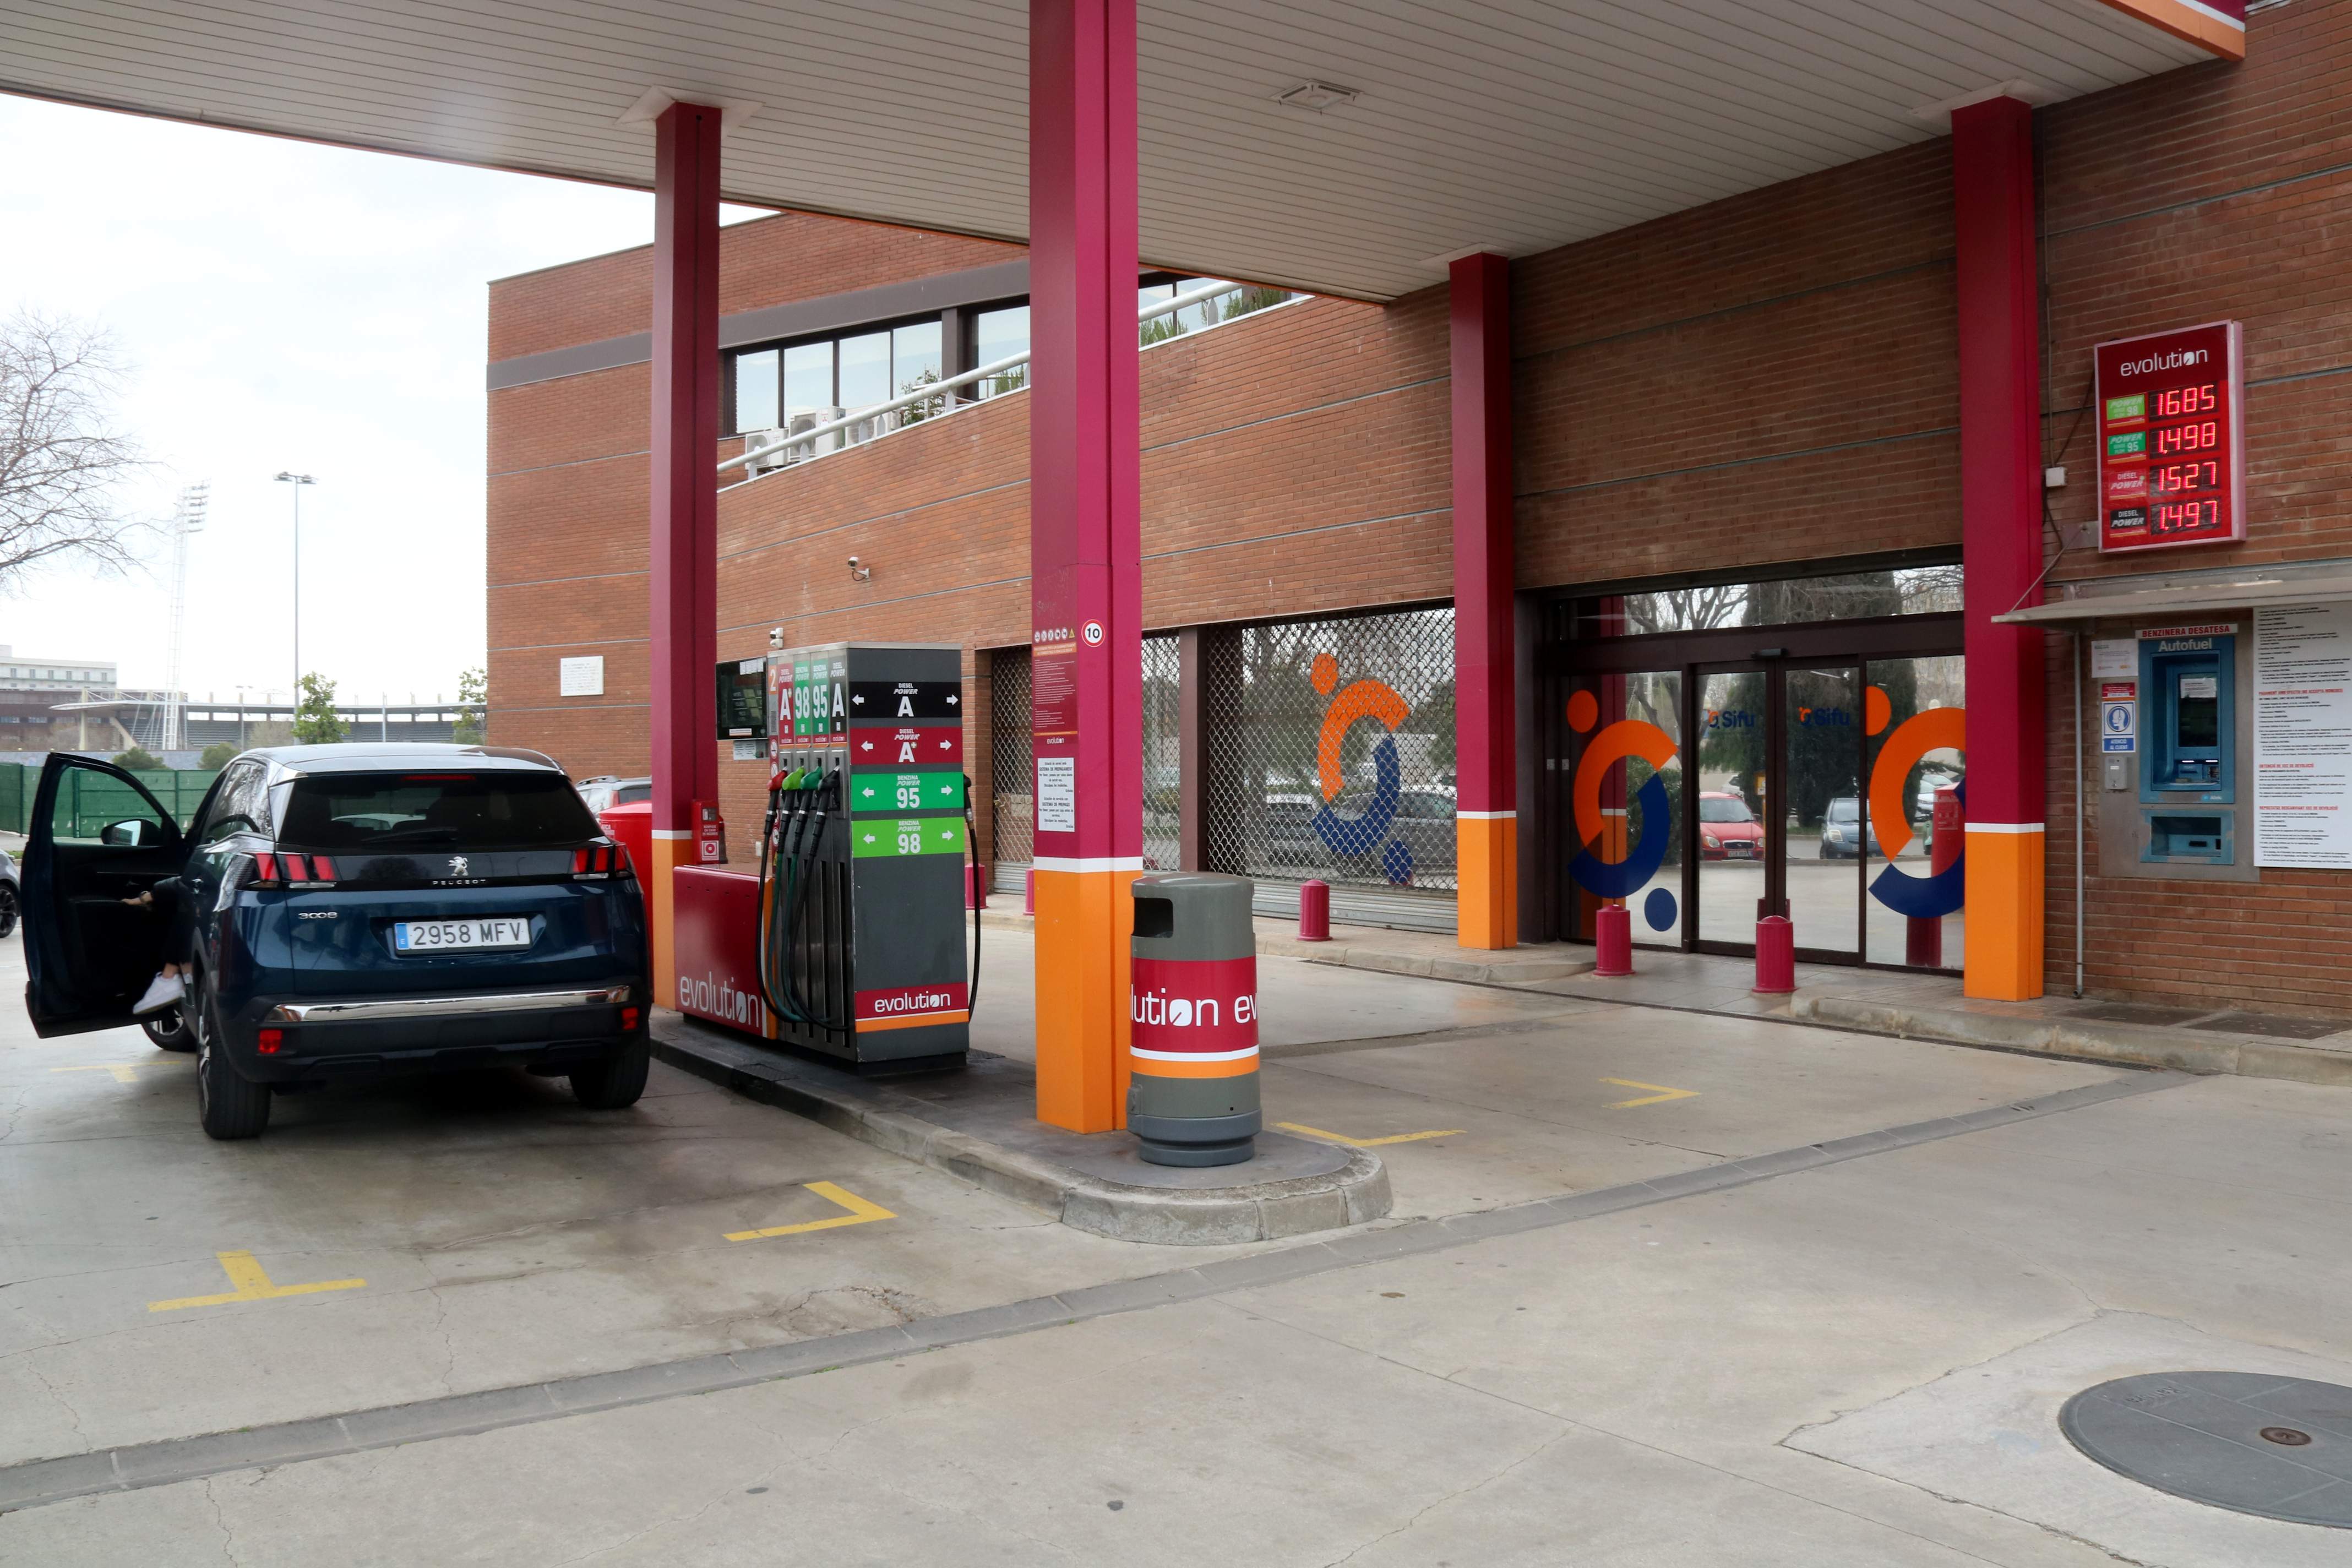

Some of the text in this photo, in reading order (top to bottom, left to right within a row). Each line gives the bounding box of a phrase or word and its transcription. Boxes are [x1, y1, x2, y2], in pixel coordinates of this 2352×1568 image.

[2120, 347, 2208, 377] evolution
[2126, 406, 2139, 416] 98
[2110, 433, 2143, 444] POWER
[2127, 442, 2139, 451] 95
[2118, 510, 2138, 518] DIESEL
[2111, 518, 2144, 527] POWER
[1087, 628, 1100, 639] 10
[2142, 625, 2230, 638] BENZINERA DESATESA
[2158, 638, 2213, 652] Autofuel
[770, 669, 776, 692] 2
[778, 675, 793, 683] POWER
[795, 673, 809, 682] POWER
[813, 671, 827, 680] POWER
[830, 669, 846, 678] POWER
[795, 686, 810, 719] 98
[813, 684, 828, 718] 95
[832, 683, 845, 717] A
[897, 696, 914, 717] A
[1722, 710, 1755, 728] Sifu
[1814, 707, 1850, 726] Sifu
[1047, 736, 1065, 744] evolution
[896, 787, 921, 808] 95
[898, 834, 921, 854] 98
[413, 922, 521, 946] 2958 MFV
[680, 975, 759, 1028] evolution
[874, 990, 951, 1013] evolution
